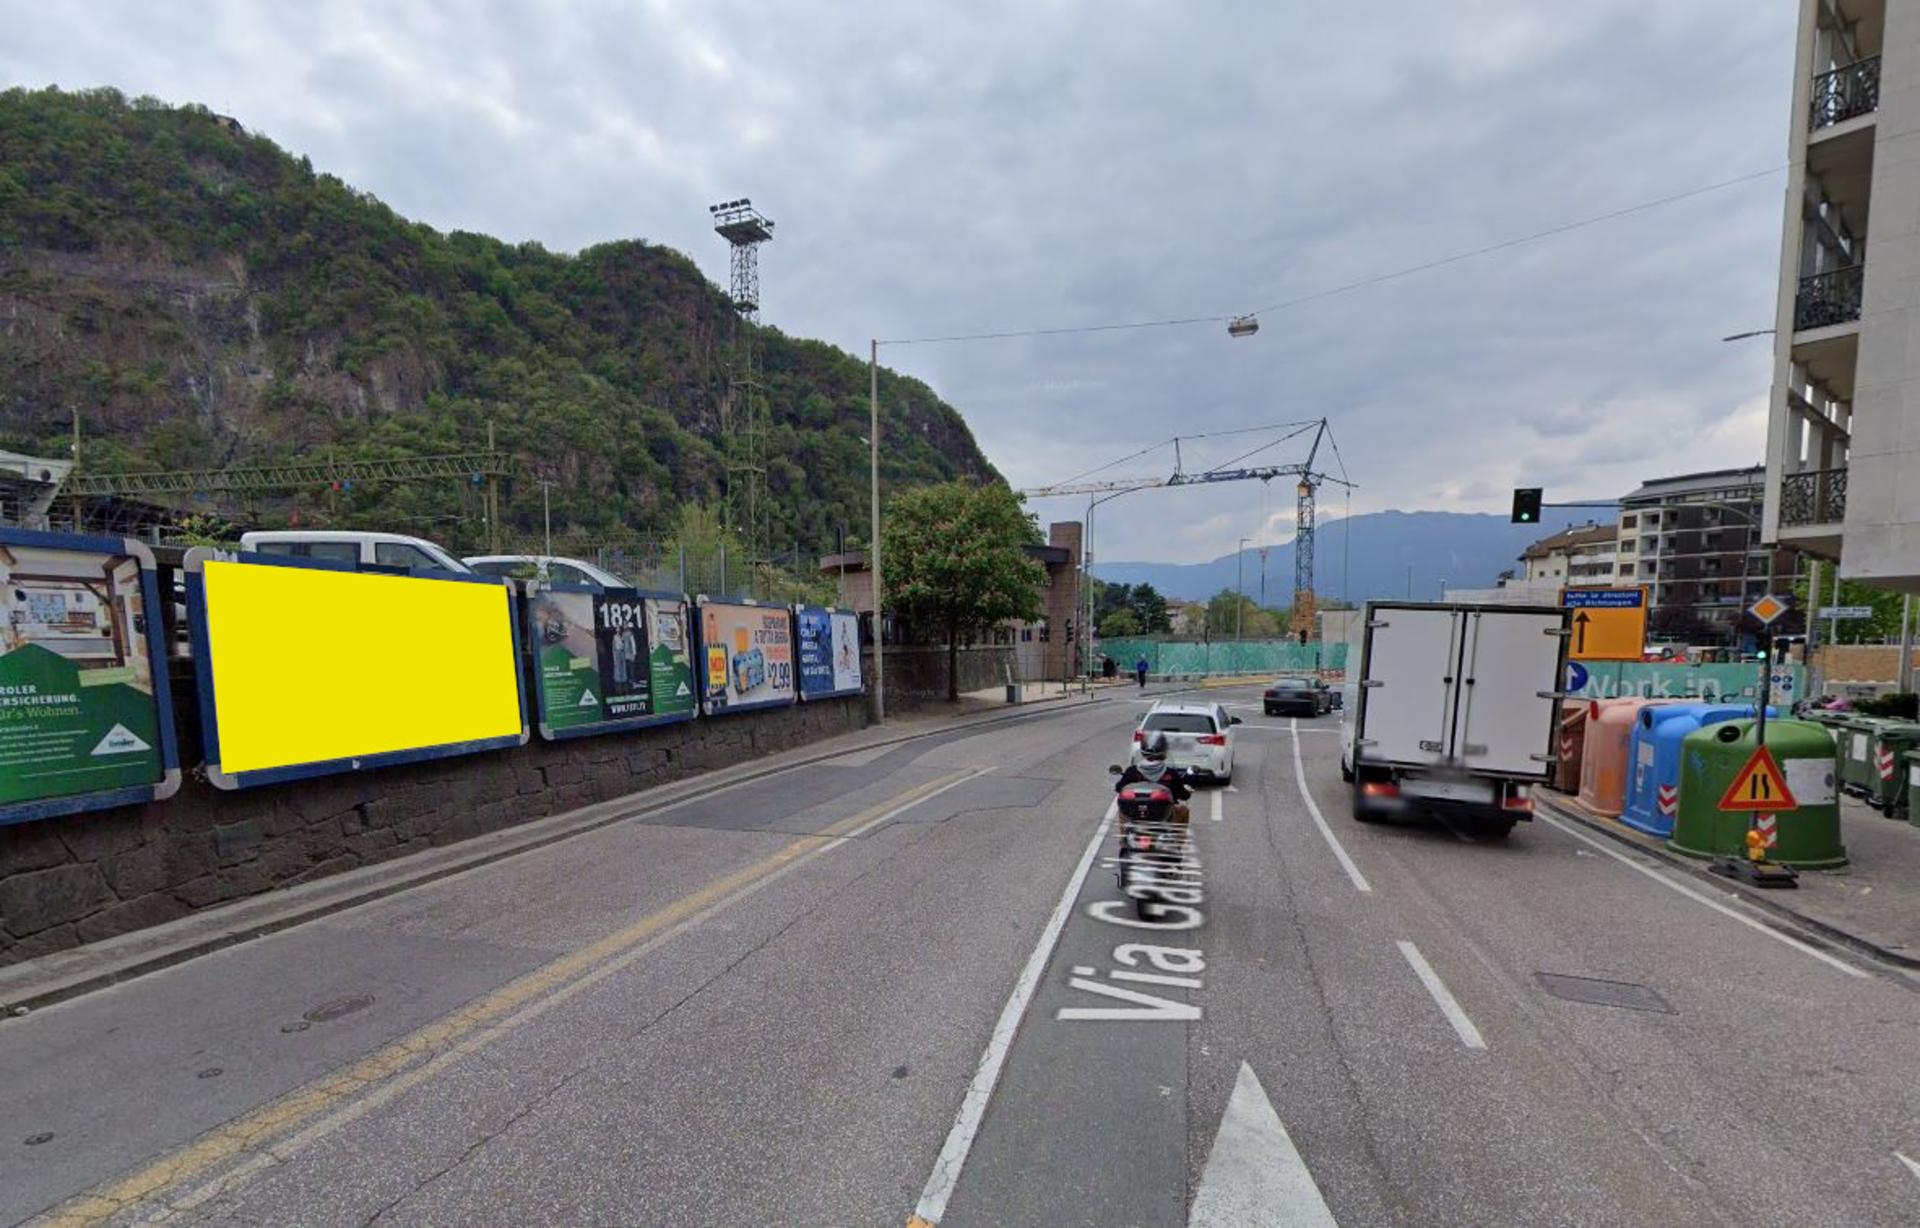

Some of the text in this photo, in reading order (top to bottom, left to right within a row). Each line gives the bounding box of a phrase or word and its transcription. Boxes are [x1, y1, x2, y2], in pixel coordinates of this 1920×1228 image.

[600, 602, 643, 629] 1821
[1583, 671, 1673, 699] Work
[1685, 670, 1722, 699] in
